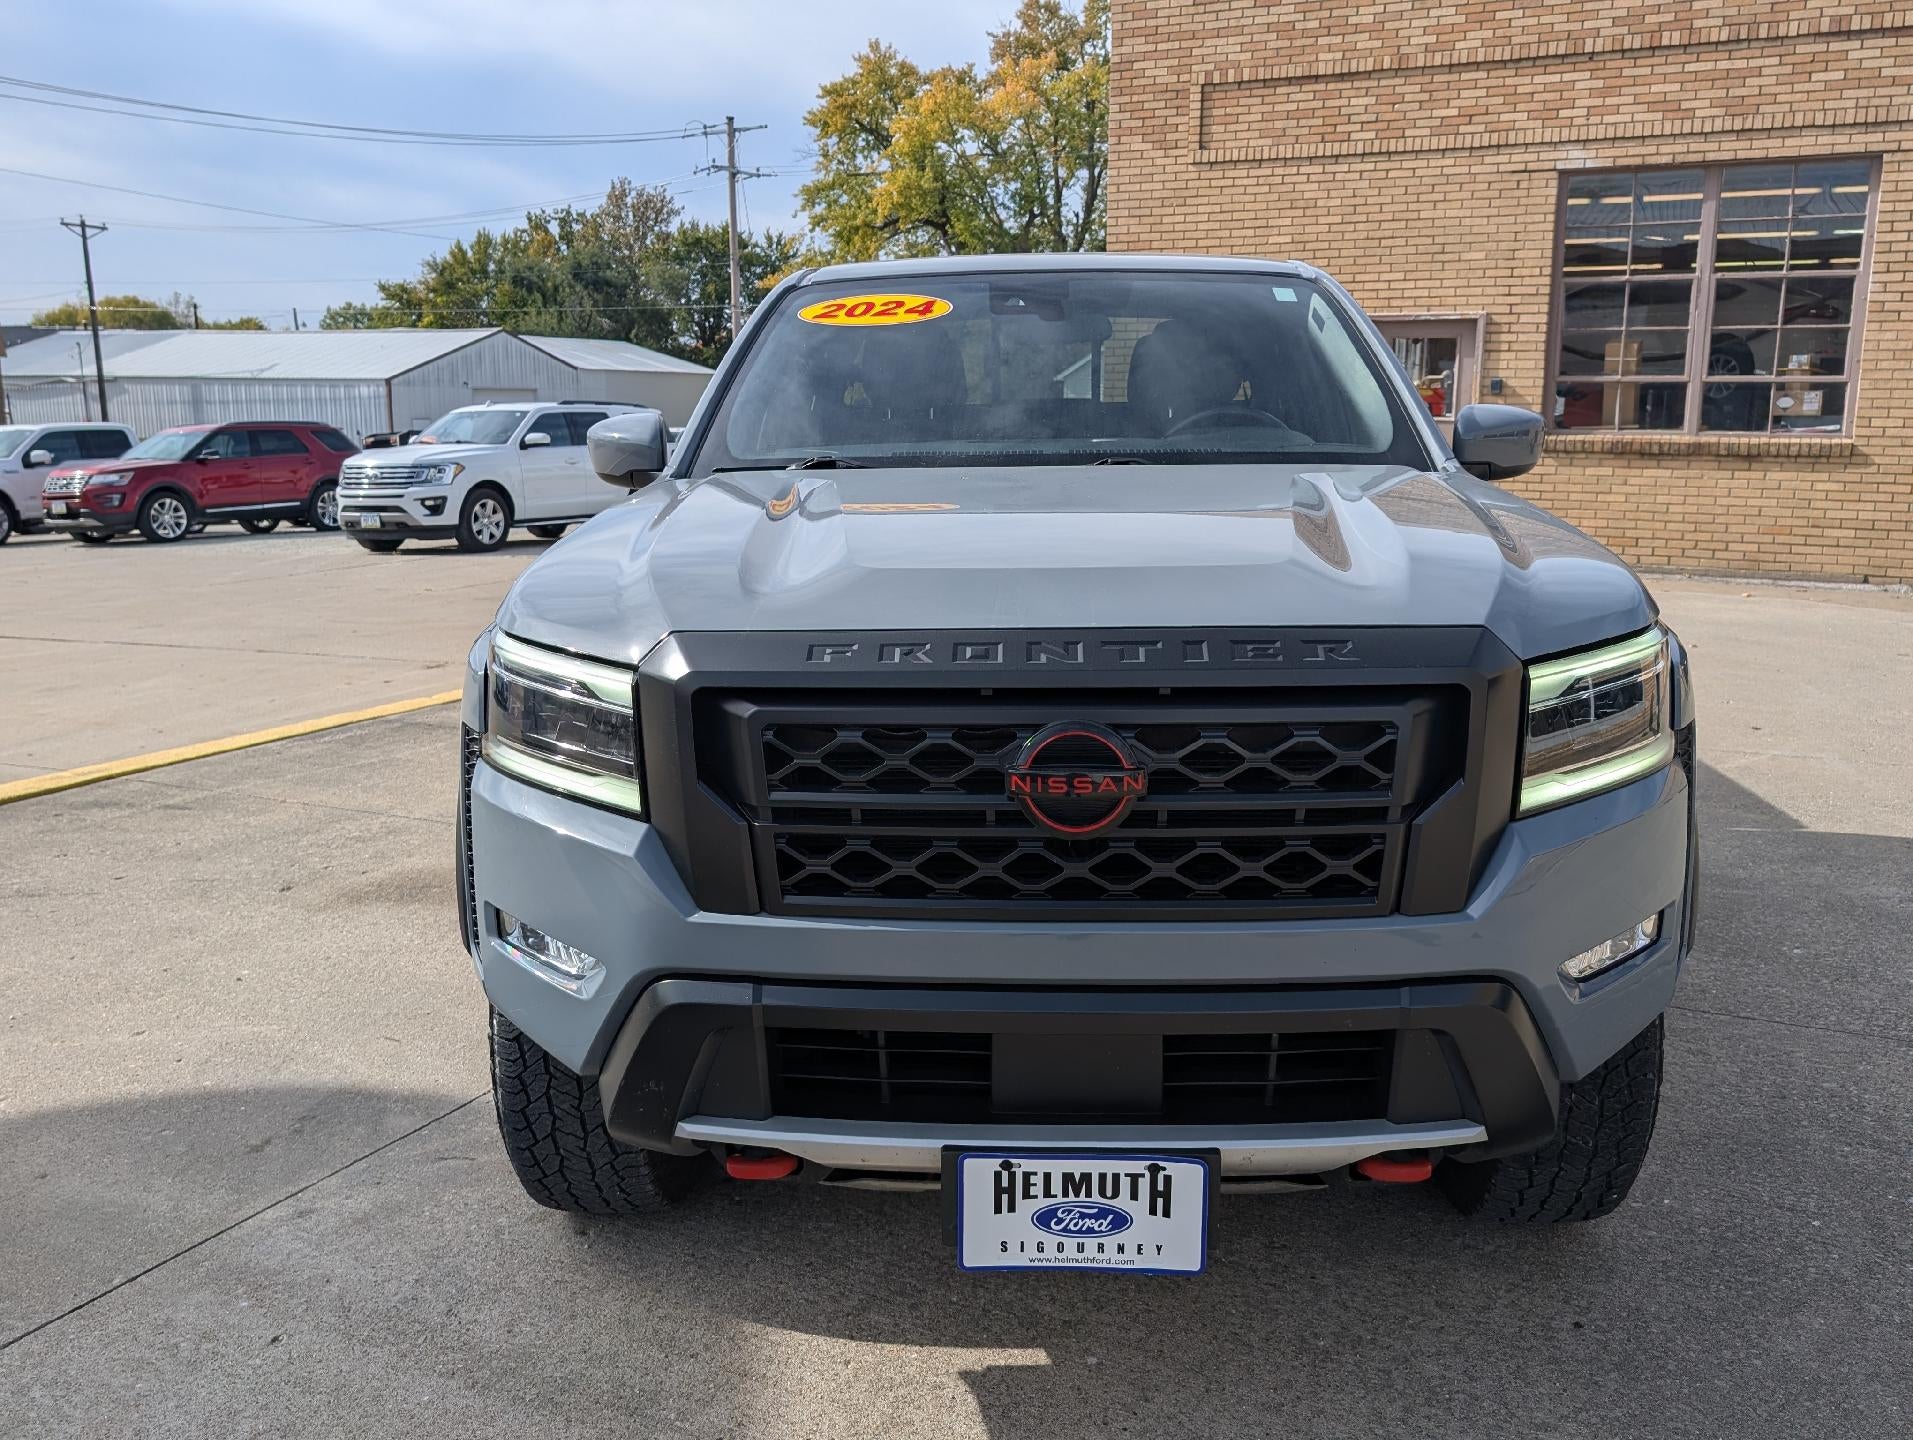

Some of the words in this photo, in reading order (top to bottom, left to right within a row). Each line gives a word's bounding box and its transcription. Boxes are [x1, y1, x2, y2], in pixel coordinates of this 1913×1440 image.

[811, 299, 939, 320] 2024
[804, 640, 1362, 664] FRONTIER
[1010, 774, 1145, 795] NISSAN
[993, 1164, 1173, 1219] HELMUTH
[1050, 1206, 1114, 1233] Ford
[1000, 1240, 1164, 1256] SIGOURNEY
[1028, 1256, 1135, 1266] www.helmuthford.com
